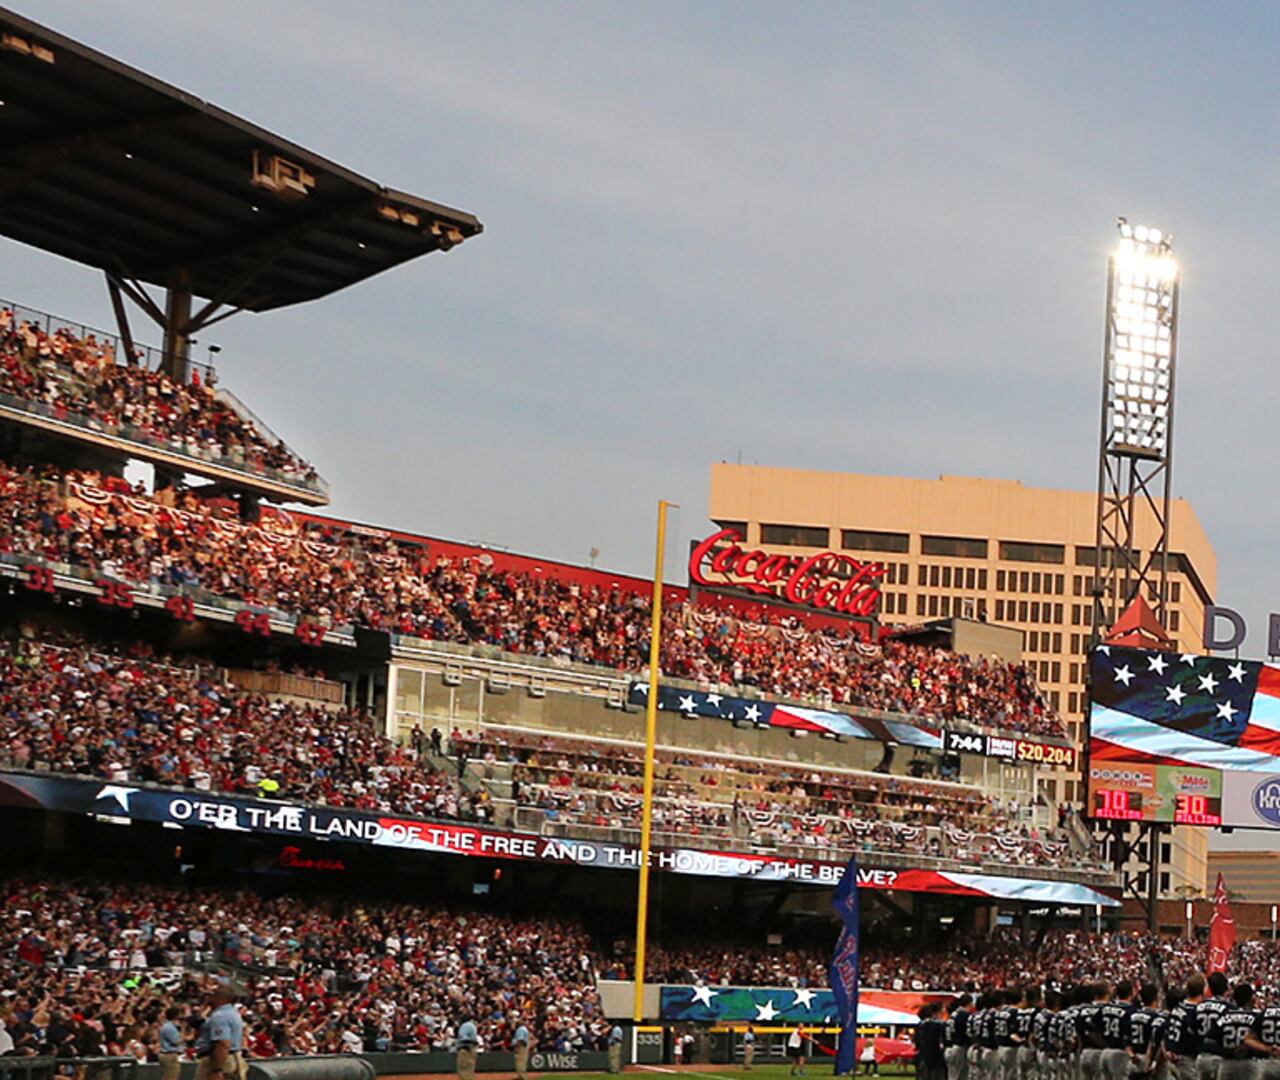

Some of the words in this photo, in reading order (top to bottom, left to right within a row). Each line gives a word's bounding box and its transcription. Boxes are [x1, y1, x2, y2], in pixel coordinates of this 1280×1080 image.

[24, 564, 55, 593] 31
[97, 580, 135, 609] 35
[165, 595, 196, 621] 41
[1018, 742, 1073, 765] $20,204
[1176, 795, 1205, 815] 30
[169, 798, 237, 826] O'ER
[245, 806, 302, 832] THE
[309, 815, 382, 841] LAND
[391, 825, 422, 844] OF
[428, 829, 475, 850] THE
[481, 835, 537, 857] FREE
[541, 839, 596, 863] AND
[603, 847, 653, 866] THE
[659, 851, 730, 874] HOME
[737, 858, 764, 875] OF
[771, 861, 813, 879] THE
[1103, 1016, 1120, 1038] 34
[548, 1054, 578, 1069] WISE
